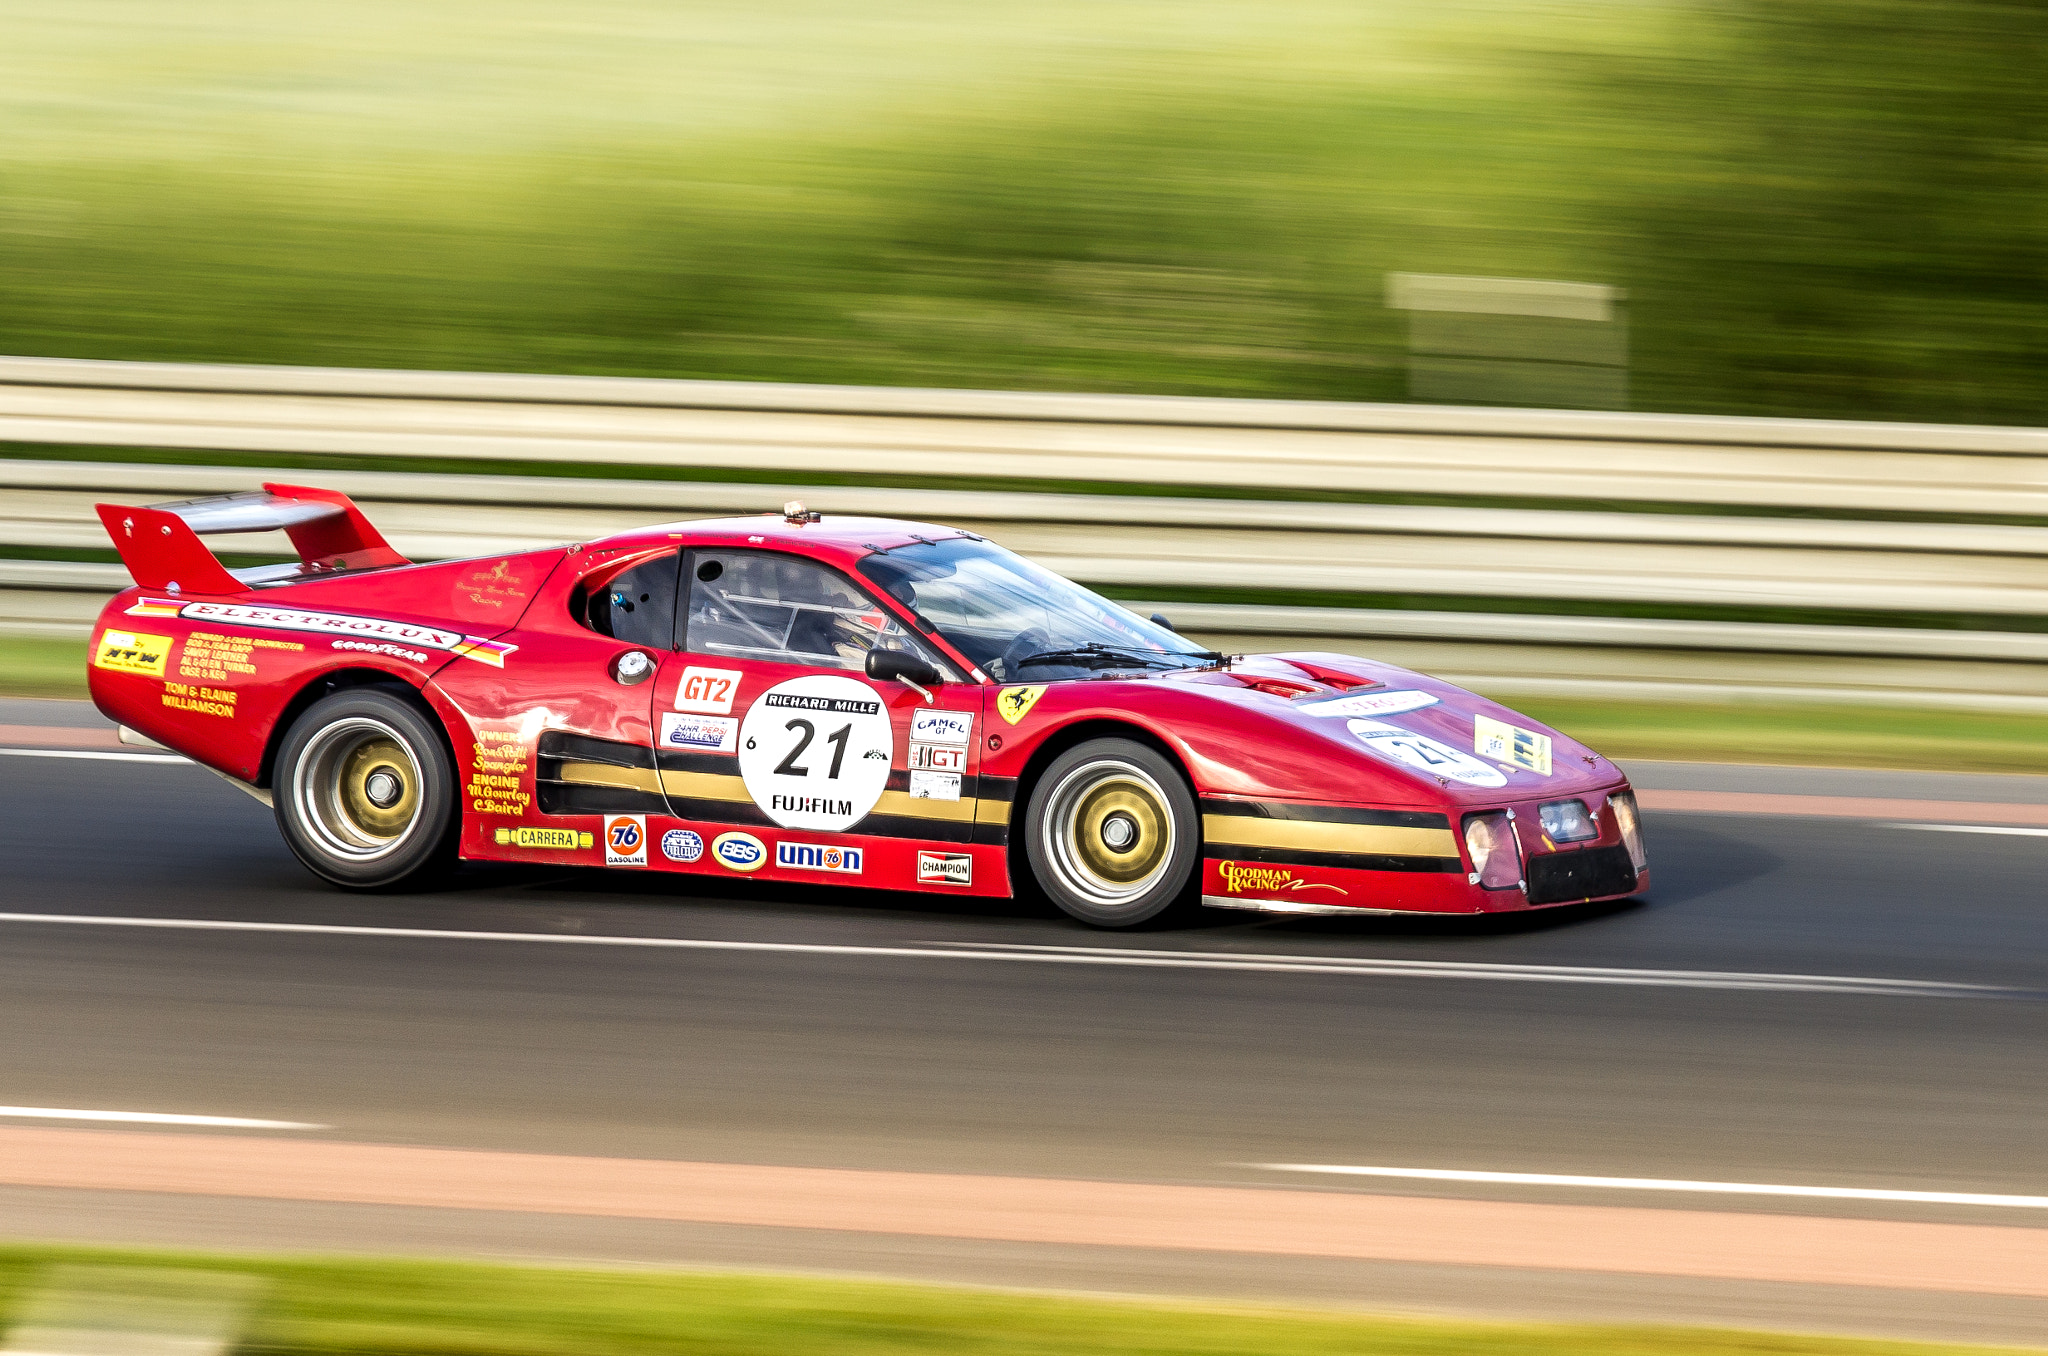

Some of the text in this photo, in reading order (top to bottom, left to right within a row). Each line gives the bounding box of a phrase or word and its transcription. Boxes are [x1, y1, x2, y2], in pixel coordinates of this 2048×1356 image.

[470, 593, 503, 608] Racing
[193, 605, 451, 645] ELECTROLUX
[211, 649, 249, 663] LEATHER
[331, 640, 429, 663] GOODYEAR
[179, 665, 201, 678] CASE
[180, 656, 192, 666] AL
[223, 661, 257, 675] TURNER
[164, 681, 238, 705] TOM & ELAINE
[684, 676, 732, 703] GT2
[161, 694, 235, 719] WILLIAMSON
[768, 694, 877, 713] RICHARD MILLE
[701, 726, 728, 736] PEPSI
[917, 718, 965, 733] CAMEL
[935, 727, 946, 735] GT
[479, 730, 523, 743] OWNERS
[670, 731, 724, 747] CHALLENGE
[746, 736, 757, 750] 6
[773, 718, 853, 780] 21
[932, 749, 964, 767] GT
[1392, 740, 1461, 765] 21
[472, 755, 528, 775] Spangler
[472, 773, 520, 789] ENGINE
[772, 795, 852, 816] FUJIFILM
[521, 830, 573, 847] CARRERA
[612, 824, 638, 846] 76
[721, 841, 758, 860] BBS
[826, 852, 840, 864] 76
[922, 861, 967, 875] CHAMPION
[1218, 860, 1292, 881] GOODMAN
[1227, 868, 1280, 893] RACING
